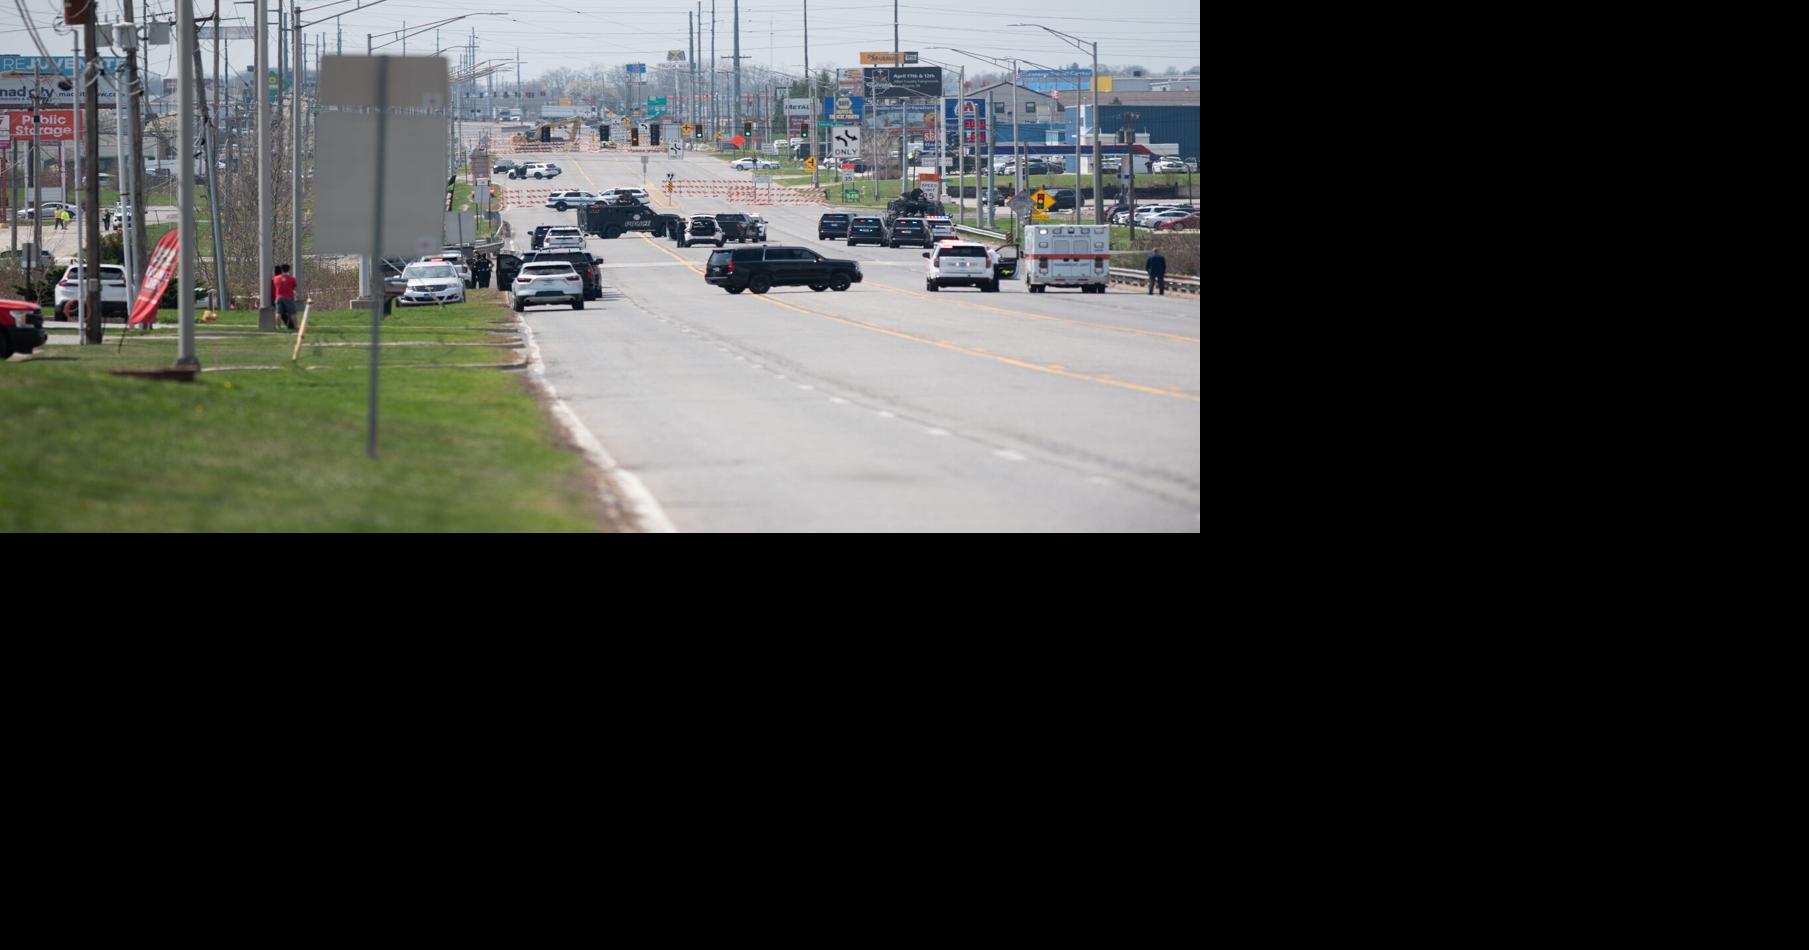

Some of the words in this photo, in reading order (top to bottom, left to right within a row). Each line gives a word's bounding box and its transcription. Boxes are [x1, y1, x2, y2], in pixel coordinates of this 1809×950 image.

[4, 58, 127, 70] REJUVETE
[28, 86, 54, 99] cty
[15, 125, 72, 137] Storage
